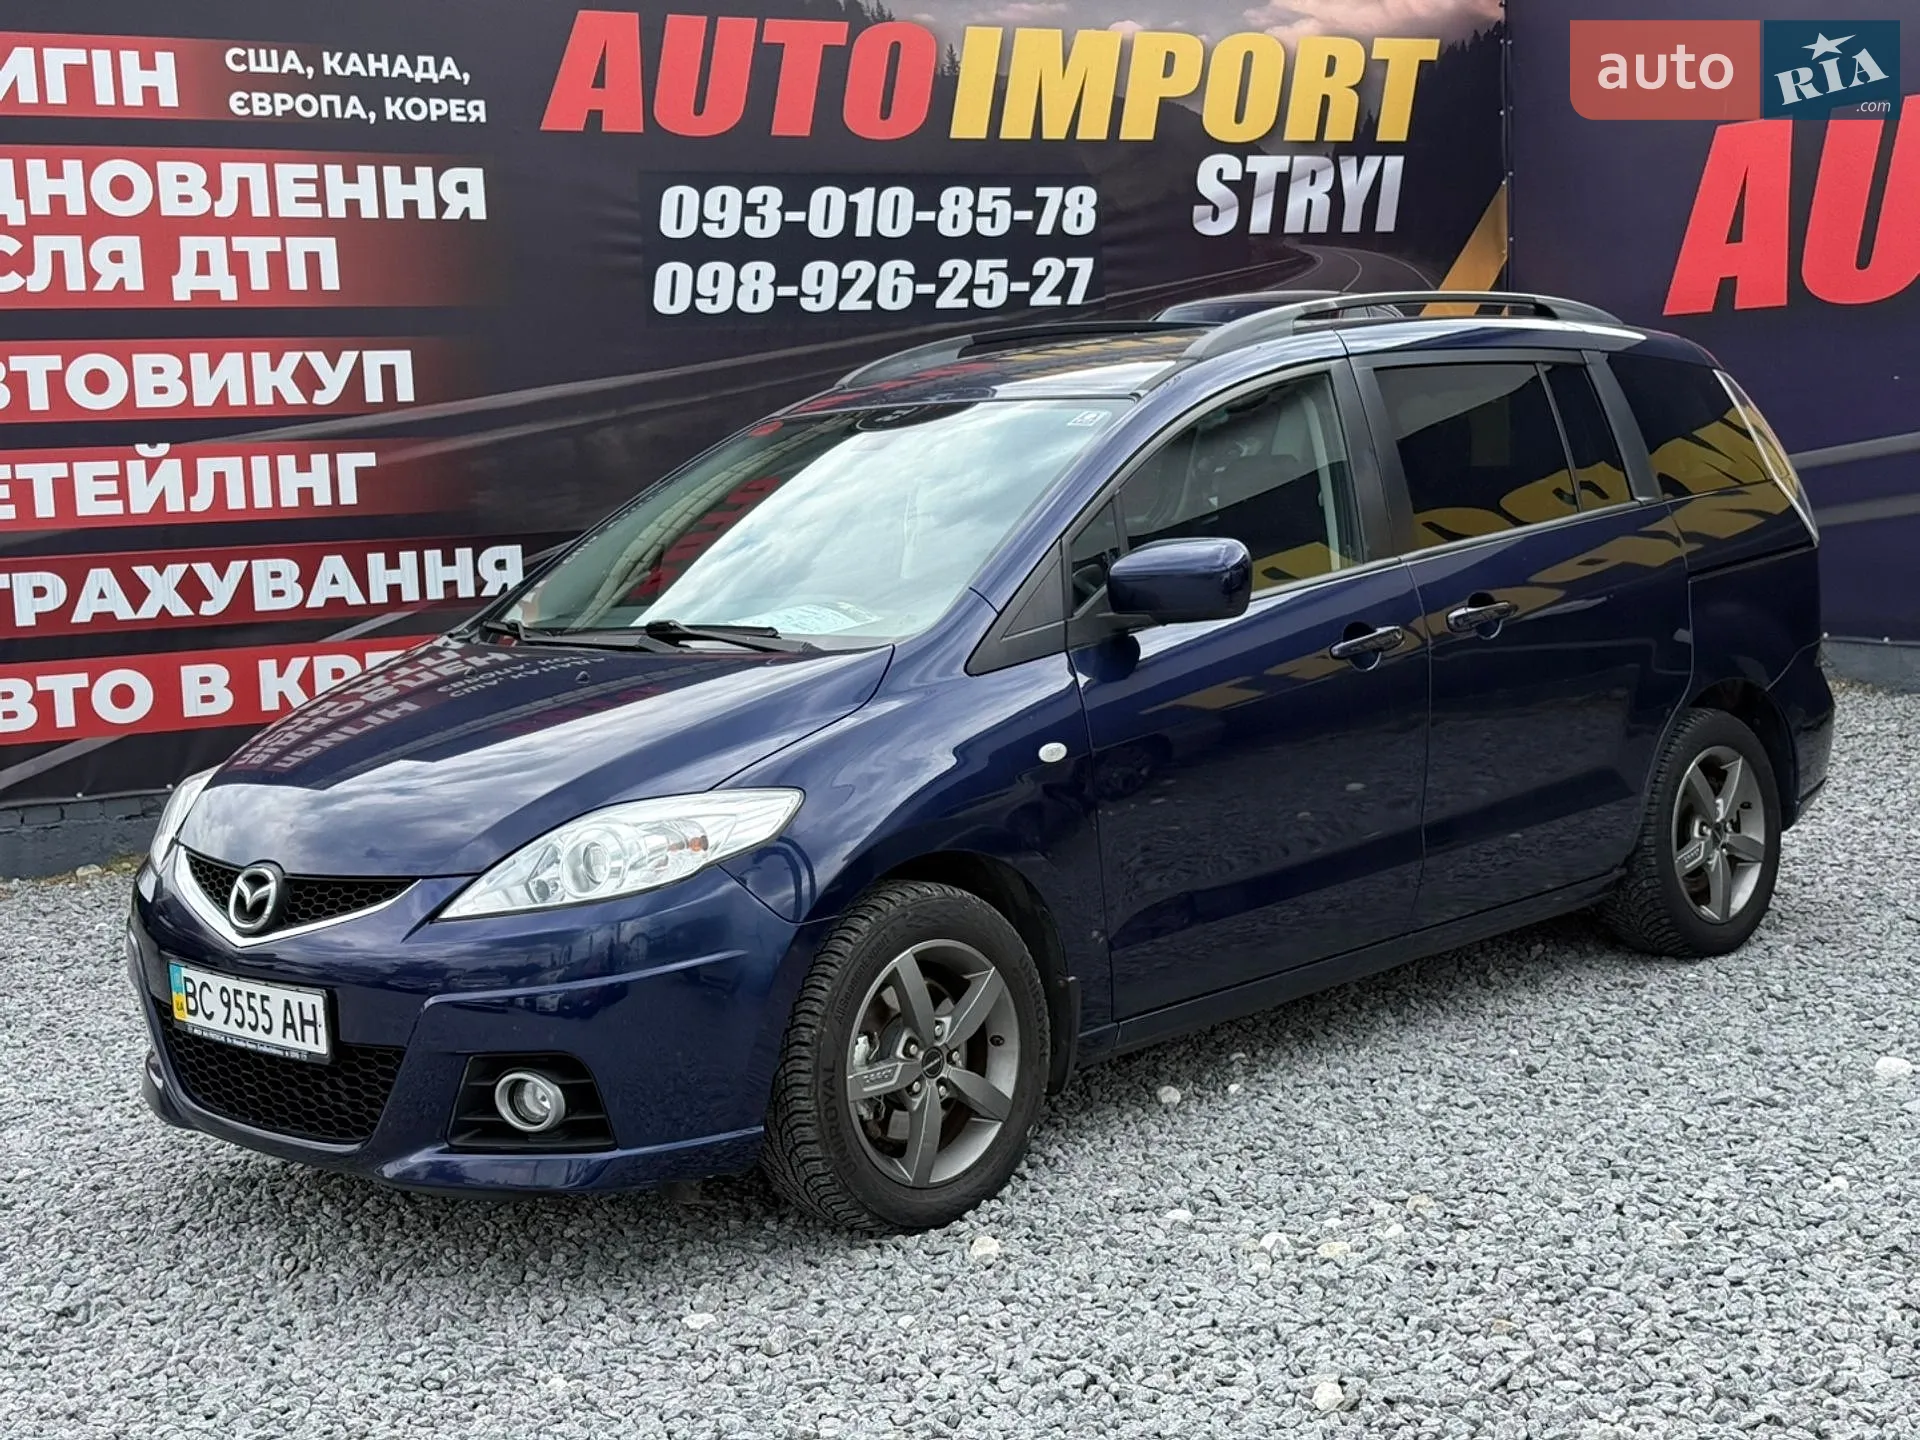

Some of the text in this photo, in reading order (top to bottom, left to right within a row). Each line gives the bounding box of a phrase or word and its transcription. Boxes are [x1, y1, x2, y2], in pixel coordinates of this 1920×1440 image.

[225, 47, 471, 83] США, КАНАДА,
[540, 9, 1440, 143] AUTO IMPORT
[228, 91, 487, 123] ЄВРОПА, КОРЕЯ
[659, 184, 1098, 239] 093-010-85-78
[1192, 153, 1405, 236] STRYI
[172, 236, 340, 301] ДТП
[653, 257, 1094, 315] 098-926-25-27
[0, 350, 415, 411] ТОВИКУП
[0, 544, 524, 626] РАХУВАННЯ
[181, 663, 235, 718] В
[183, 976, 215, 1021] BC
[220, 986, 273, 1035] 9555
[282, 999, 320, 1046] AH
[822, 1060, 858, 1179] UNIROYAL
